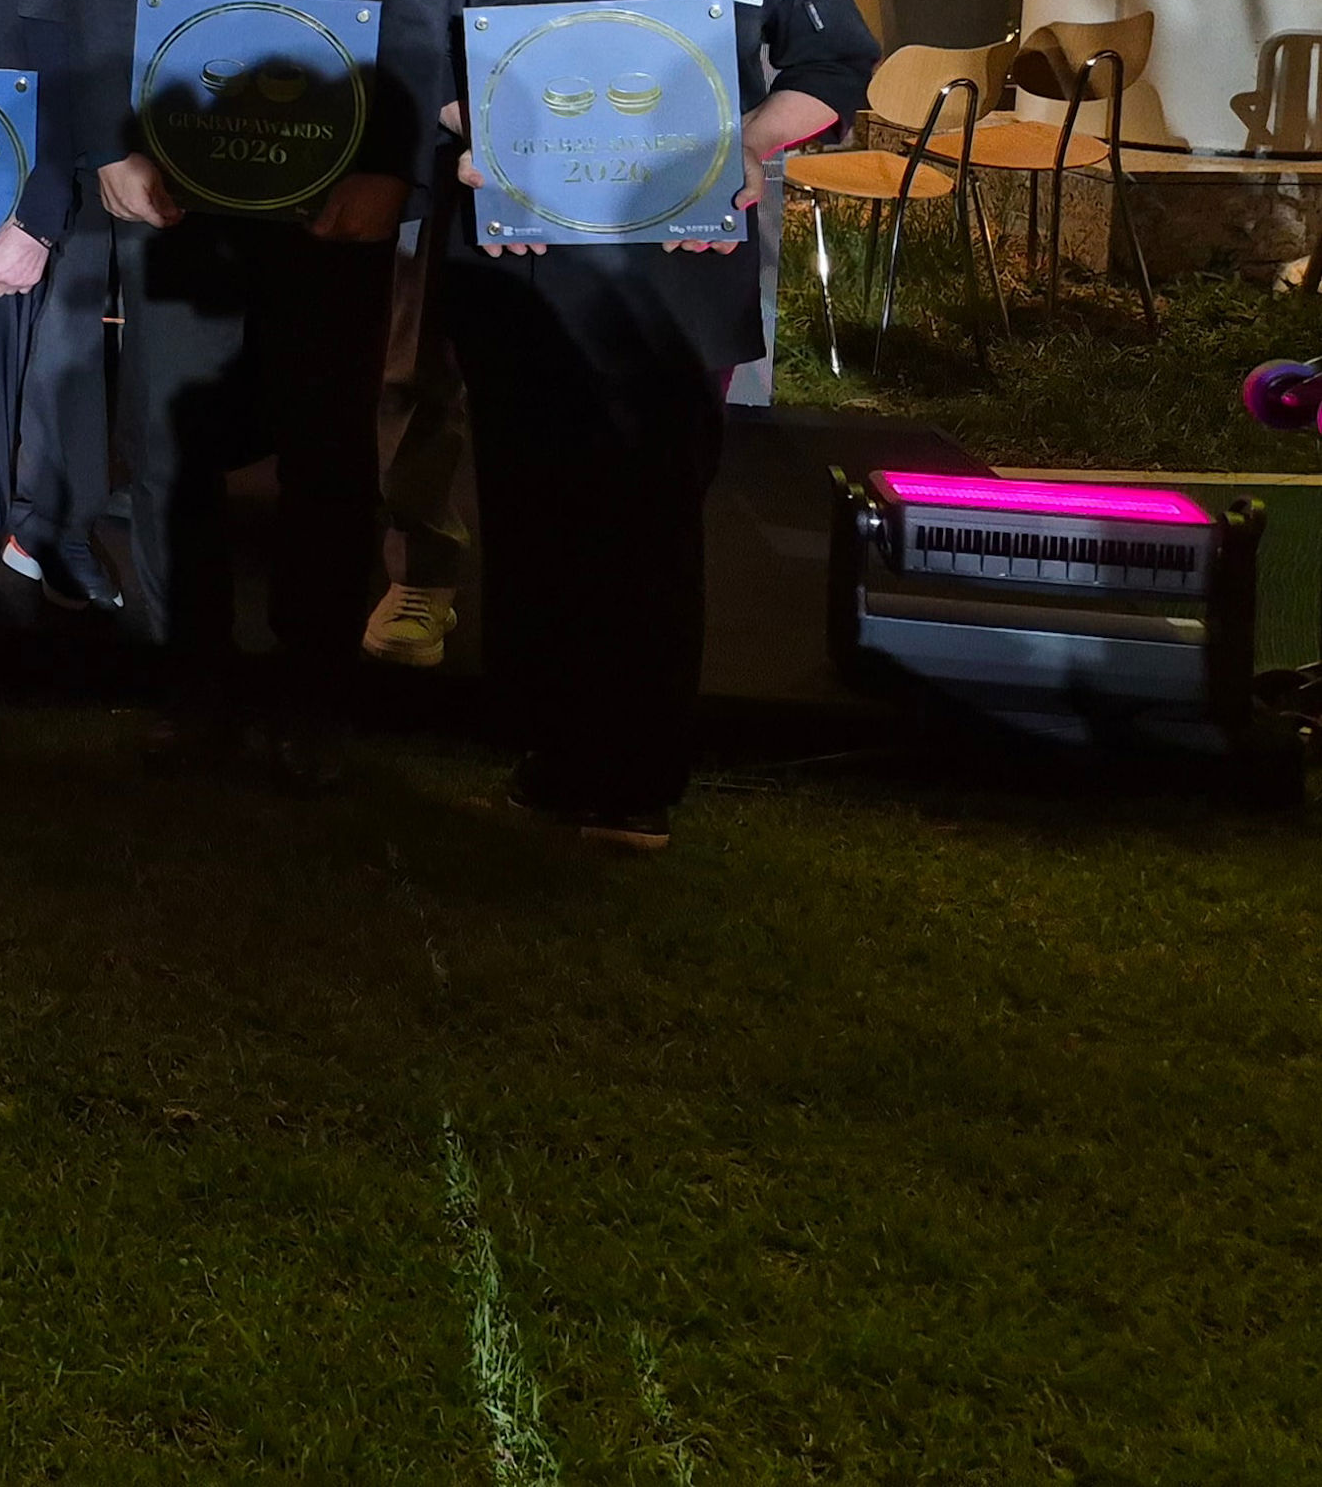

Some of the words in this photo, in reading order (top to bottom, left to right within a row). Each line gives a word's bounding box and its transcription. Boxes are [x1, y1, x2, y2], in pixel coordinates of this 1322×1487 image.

[253, 118, 334, 140] AWARDS
[209, 135, 288, 164] 2026
[563, 159, 653, 184] 2026
